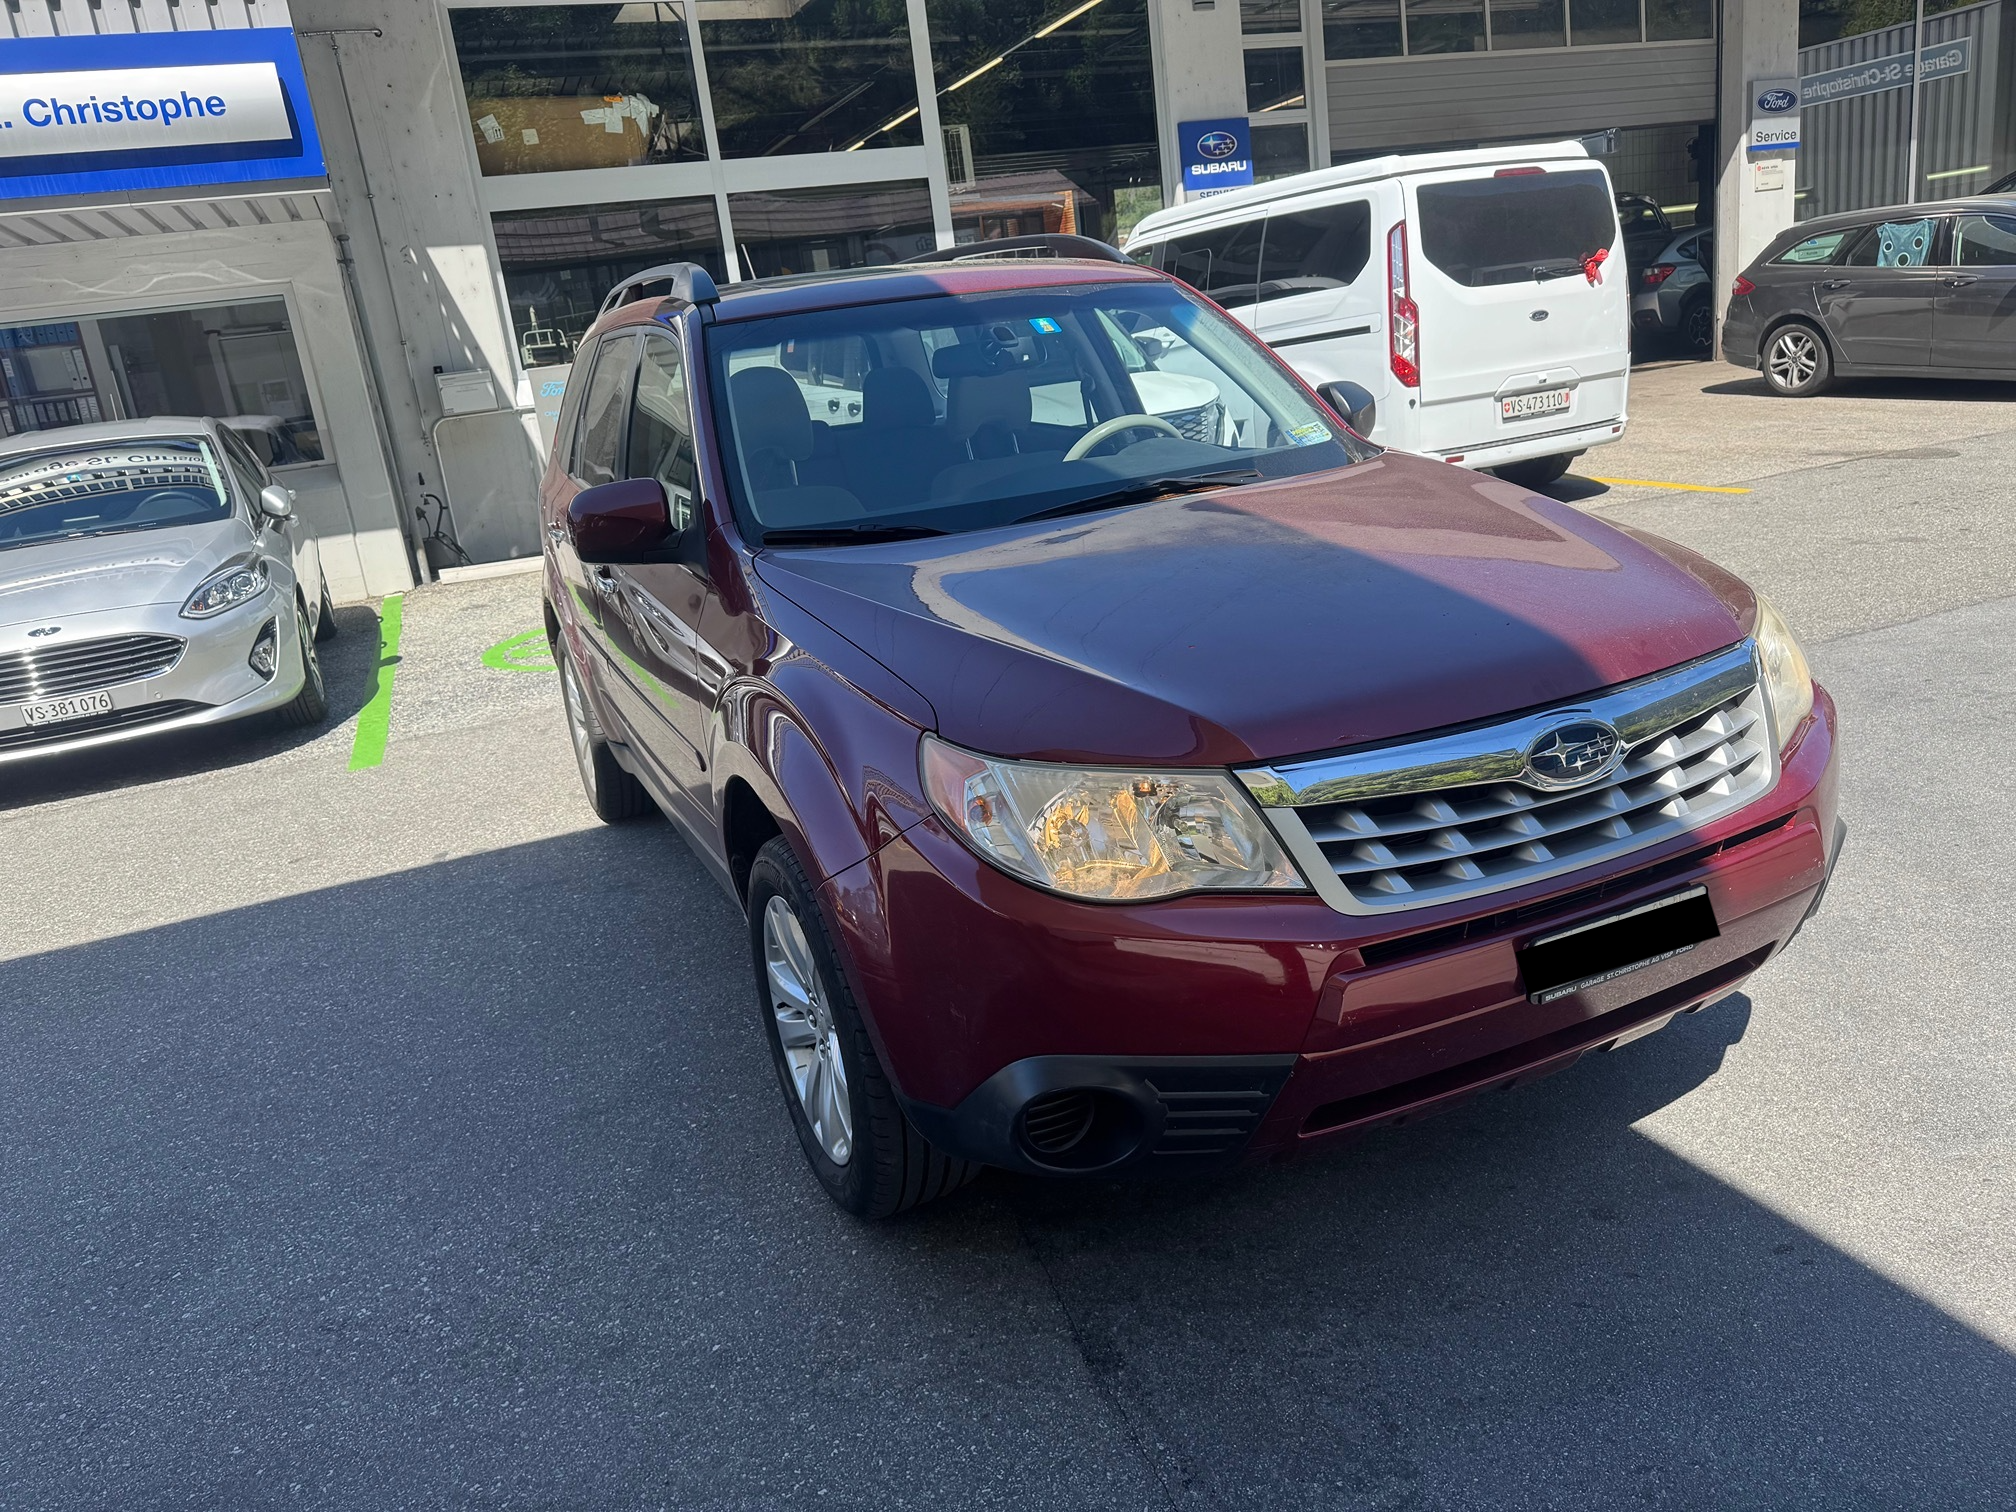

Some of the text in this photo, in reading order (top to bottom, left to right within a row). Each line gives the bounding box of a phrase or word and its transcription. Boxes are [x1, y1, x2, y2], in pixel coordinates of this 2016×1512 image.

[22, 91, 227, 127] Christophe
[1764, 92, 1790, 109] Ford
[1755, 129, 1797, 143] Service
[1191, 160, 1247, 175] SUBARU
[540, 381, 565, 398] For
[1545, 986, 1577, 1001] SUBARU
[1580, 975, 1605, 989] GARAGE
[1651, 955, 1660, 964] AG
[1661, 950, 1674, 960] VISP
[1675, 943, 1694, 955] FORD
